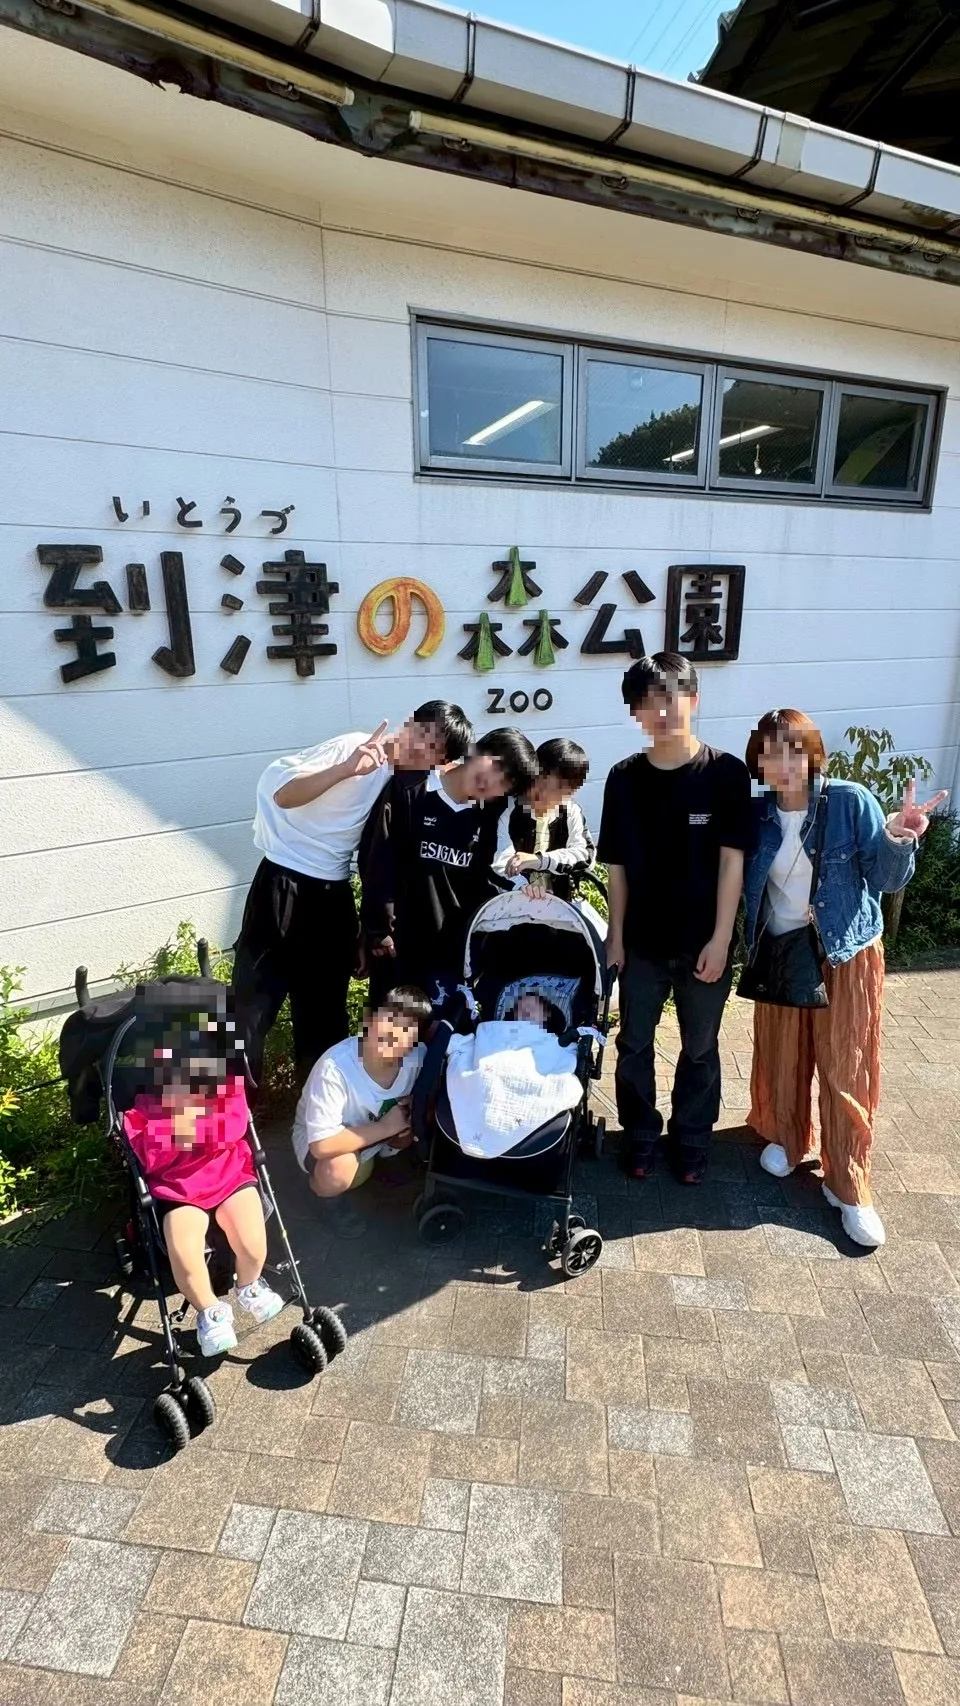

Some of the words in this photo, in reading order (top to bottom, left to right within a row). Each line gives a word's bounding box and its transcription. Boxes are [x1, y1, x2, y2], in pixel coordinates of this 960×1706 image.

[112, 495, 296, 535] いとうづ
[37, 544, 746, 683] 到津の森公園
[486, 688, 553, 714] ZOO
